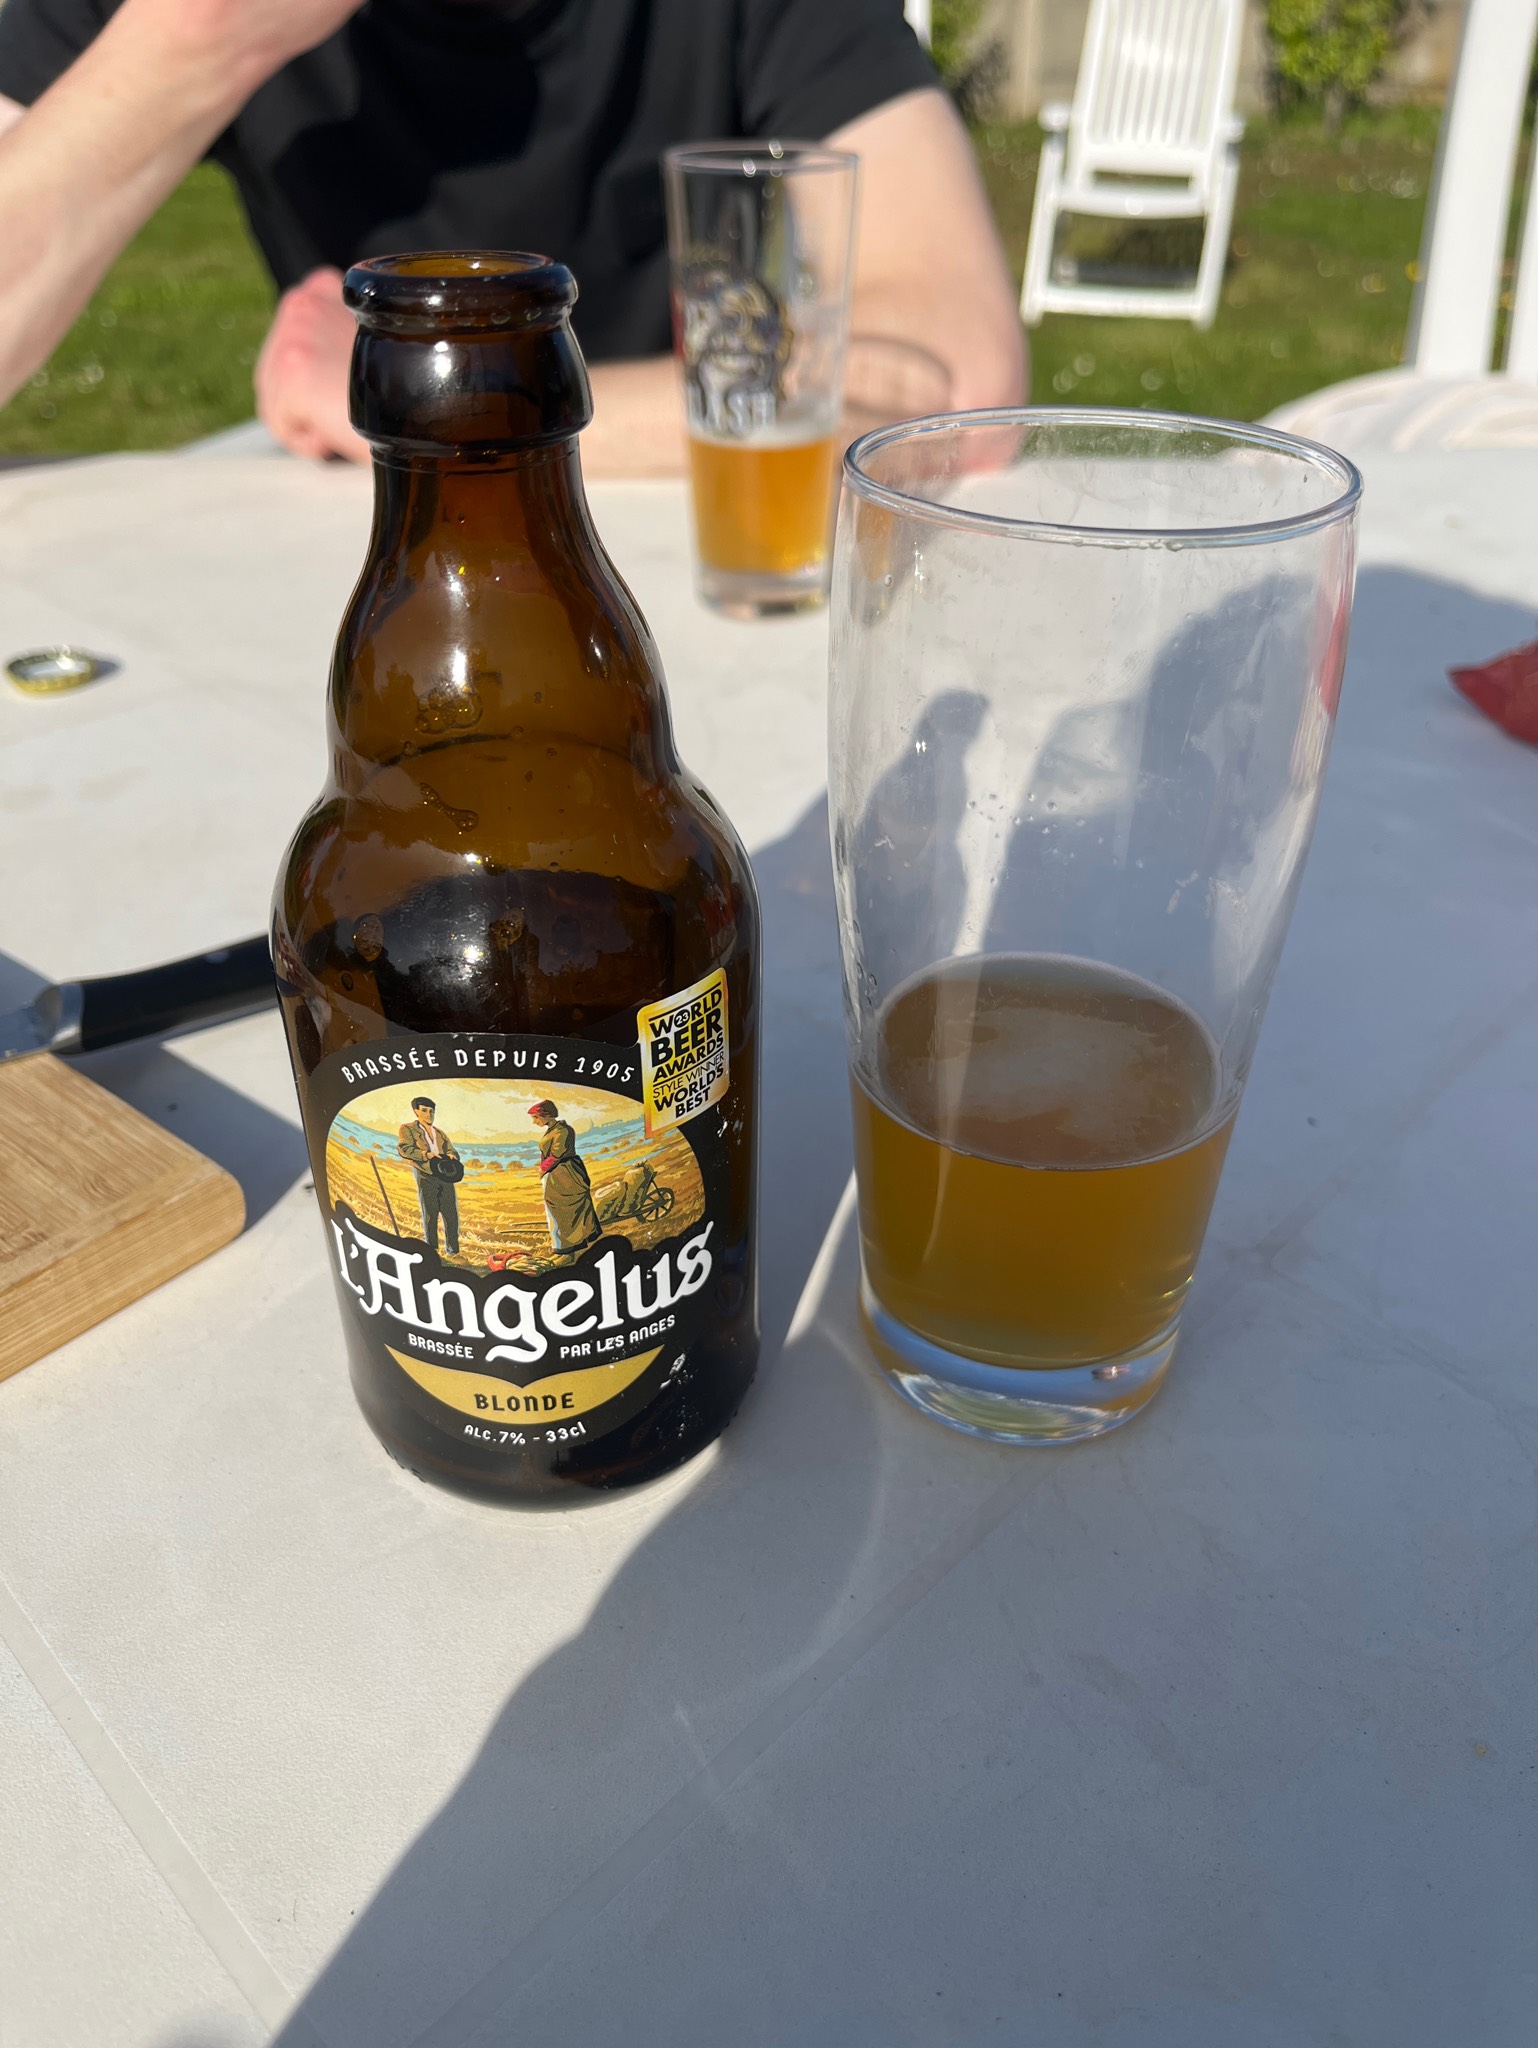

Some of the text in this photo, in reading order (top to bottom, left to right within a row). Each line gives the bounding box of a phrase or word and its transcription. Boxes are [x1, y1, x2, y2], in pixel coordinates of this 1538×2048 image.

[650, 1008, 723, 1068] BEER
[653, 1032, 724, 1083] AWARDS
[341, 1047, 635, 1084] BRASSÉE DEPUIS 1905
[653, 1051, 725, 1099] STYLE WINNER
[675, 1086, 711, 1118] BEST
[408, 1314, 676, 1360] BRASSÉE PAR LES ANGES
[474, 1391, 575, 1412] BLONDE
[547, 1421, 587, 1443] 33cl
